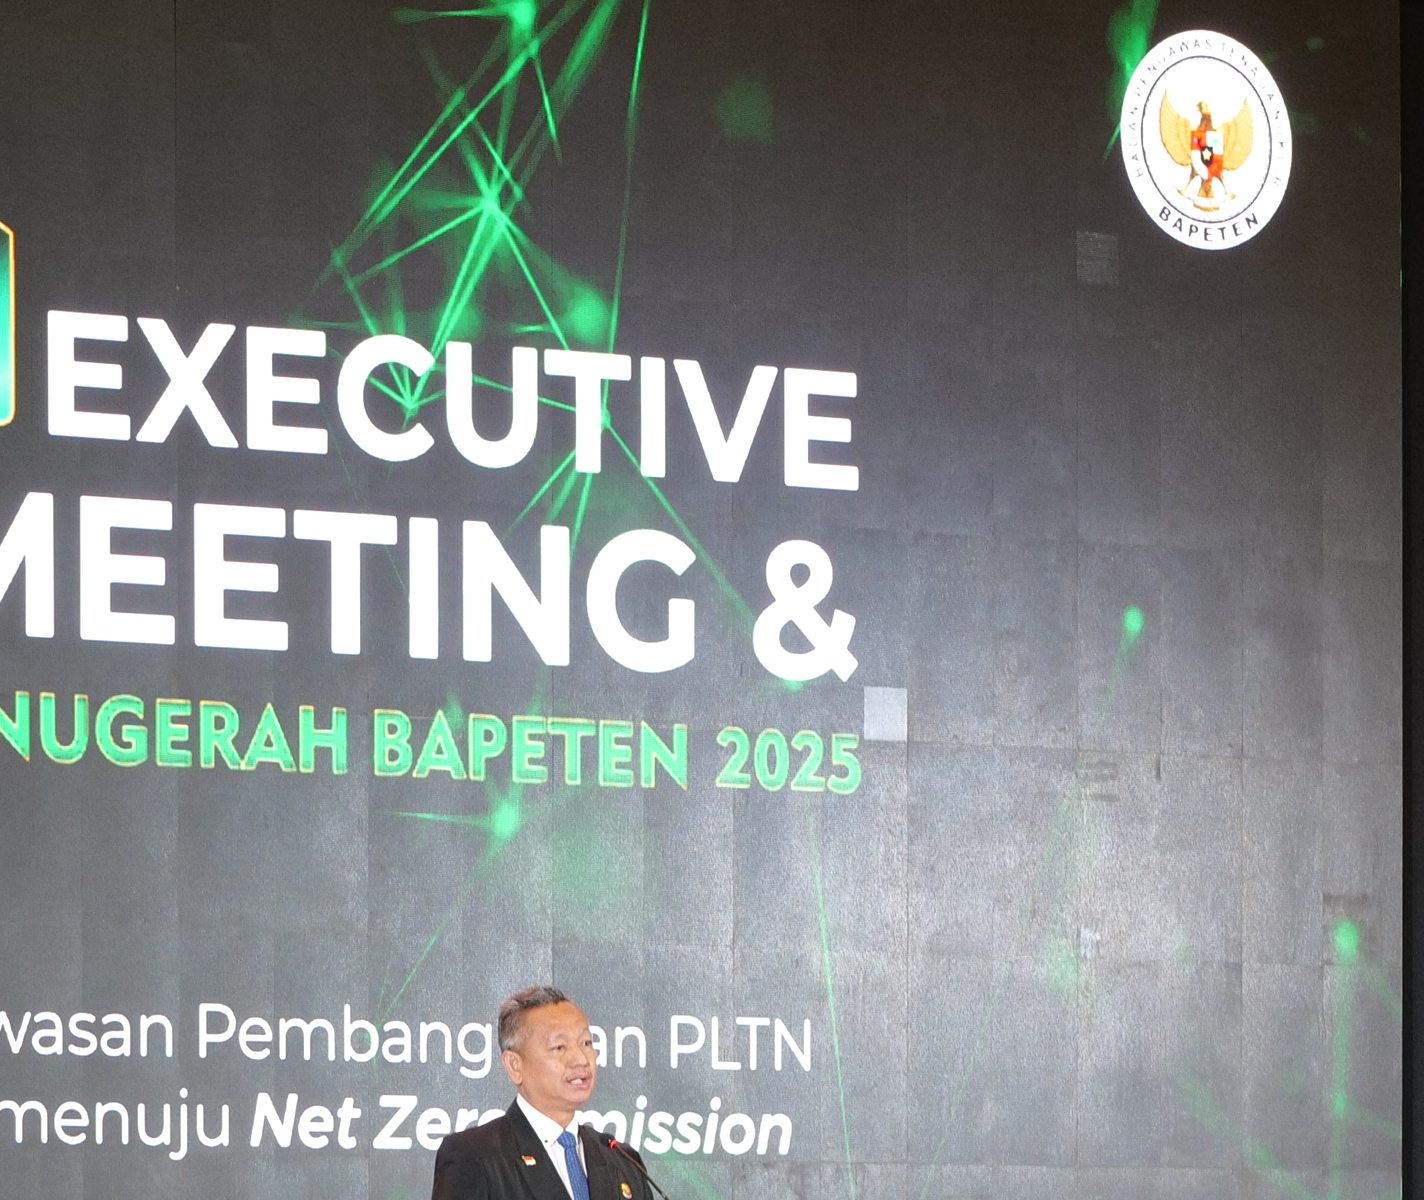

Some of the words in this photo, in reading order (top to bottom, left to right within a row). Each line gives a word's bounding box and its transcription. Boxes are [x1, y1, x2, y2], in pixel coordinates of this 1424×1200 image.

[1158, 205, 1259, 242] BAPETEN
[47, 309, 860, 492] EXECUTIVE
[751, 539, 859, 683] &
[373, 705, 689, 791] BAPETEN
[715, 726, 863, 796] 2025
[198, 1002, 647, 1080] Pembangan
[670, 1014, 811, 1072] PLTN
[249, 1091, 363, 1150] Net
[574, 1095, 793, 1156] mission
